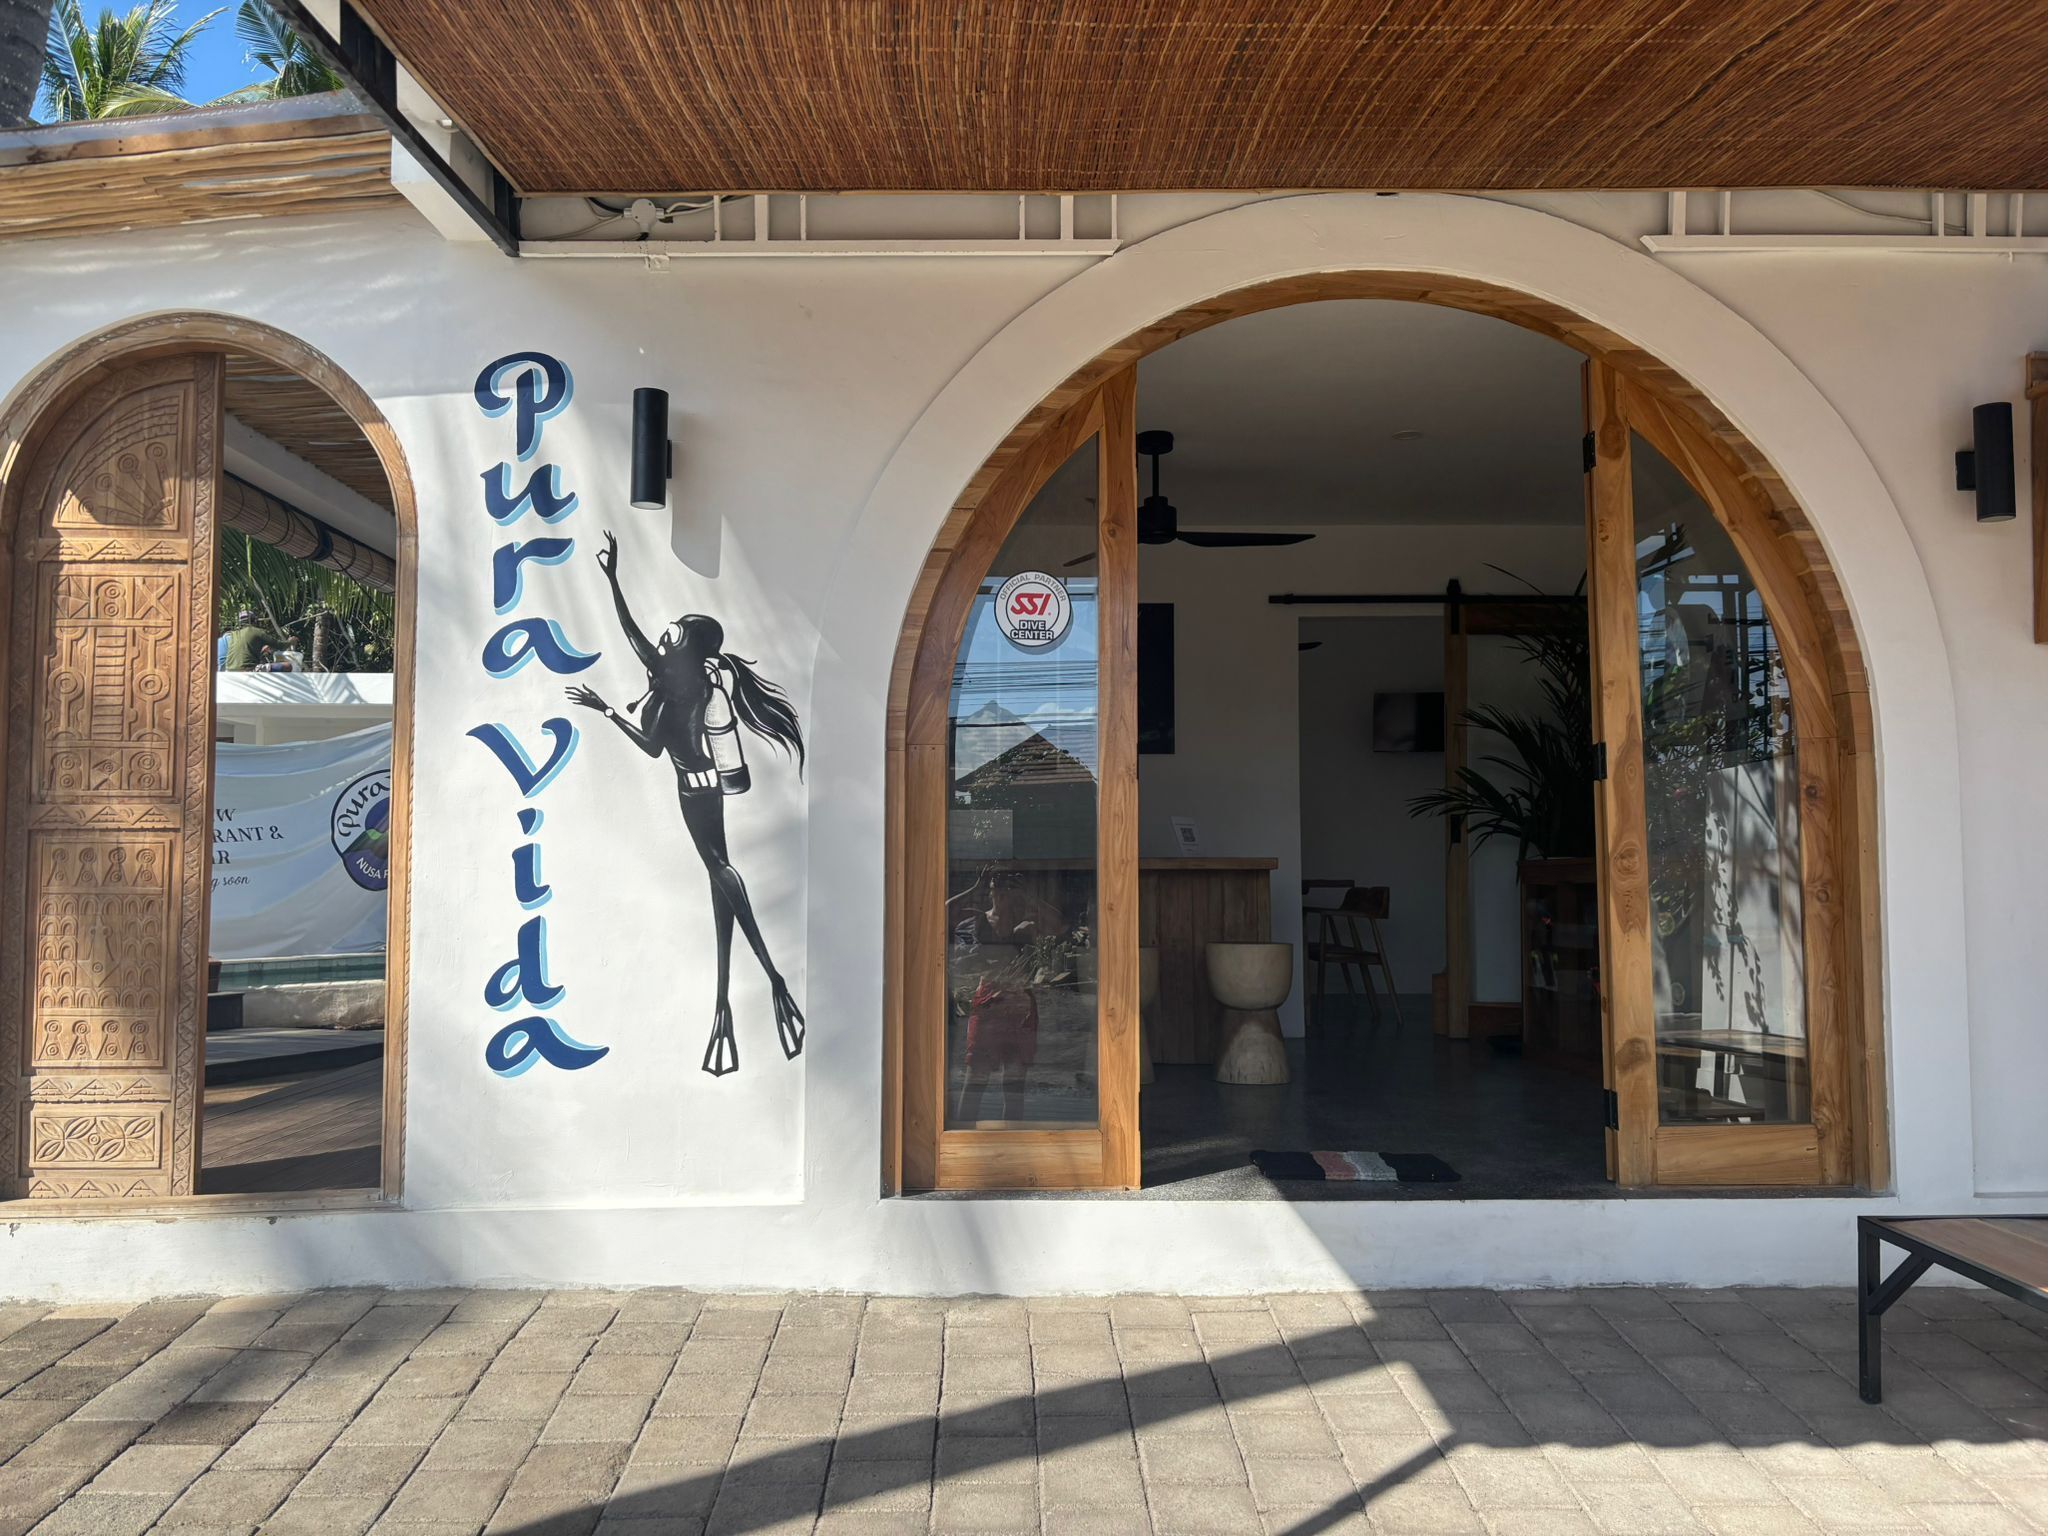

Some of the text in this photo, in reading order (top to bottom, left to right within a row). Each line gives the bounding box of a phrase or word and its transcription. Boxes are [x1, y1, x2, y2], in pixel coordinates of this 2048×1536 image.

[474, 351, 602, 680] Pura
[1000, 573, 1067, 602] OFFICIAL PARTNER
[1010, 593, 1052, 616] SSI
[1019, 620, 1046, 630] DIVE
[1011, 630, 1053, 640] CENTER
[213, 808, 237, 822] W
[269, 825, 285, 840] &
[356, 857, 381, 879] NUSA
[222, 875, 250, 886] soon
[465, 717, 611, 1078] Vida
